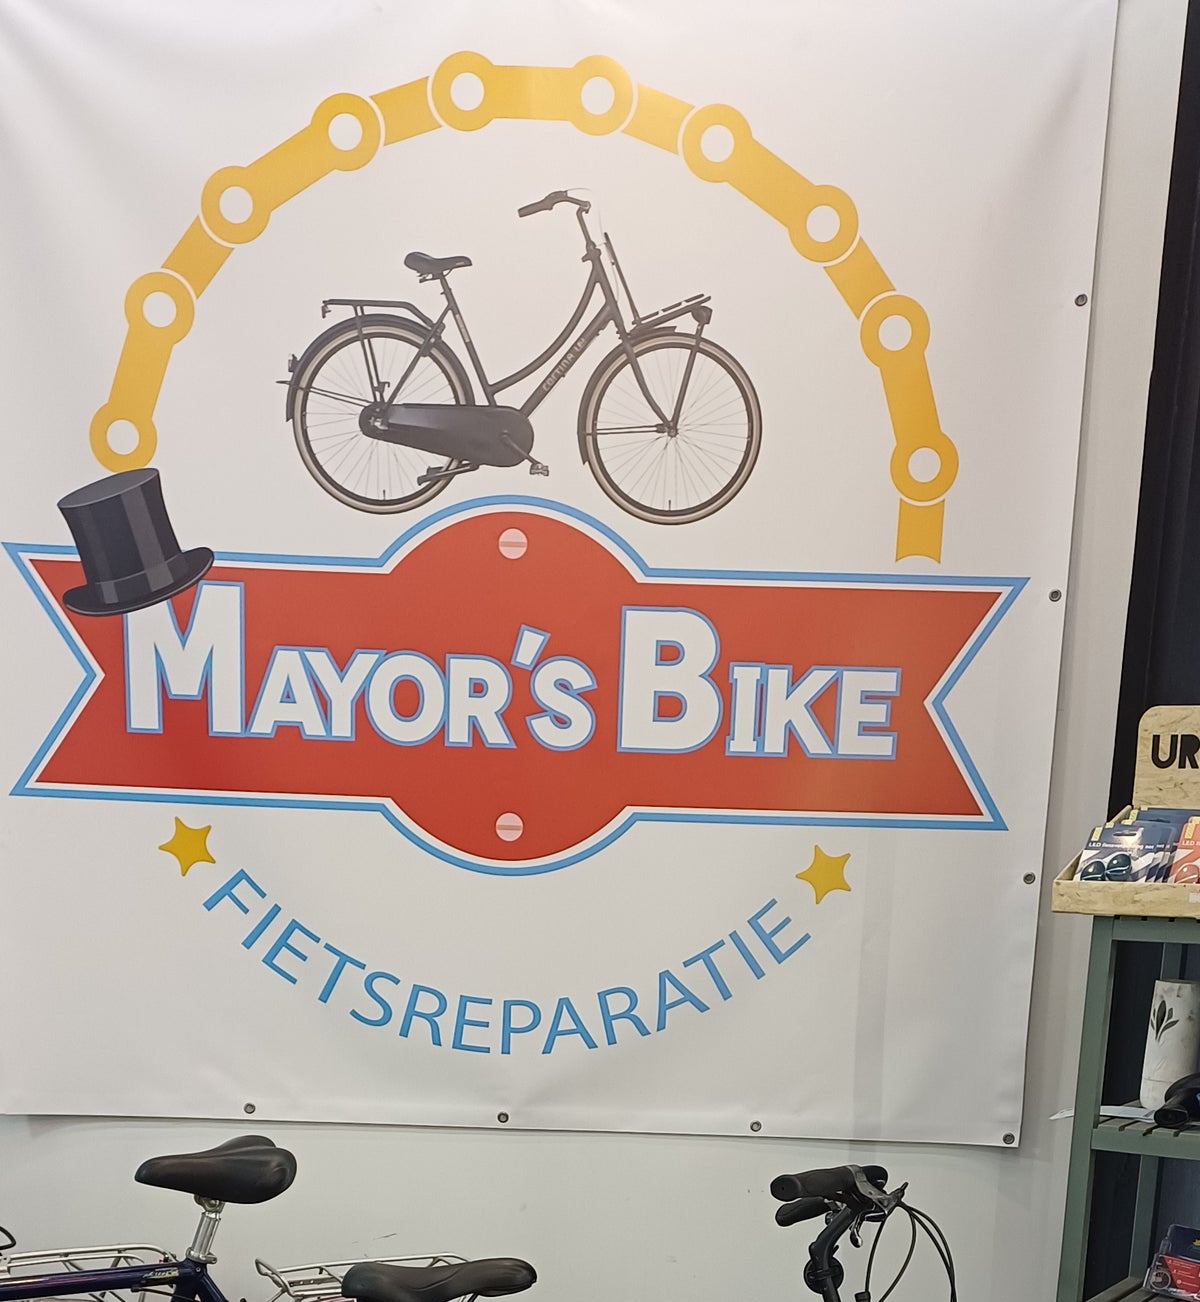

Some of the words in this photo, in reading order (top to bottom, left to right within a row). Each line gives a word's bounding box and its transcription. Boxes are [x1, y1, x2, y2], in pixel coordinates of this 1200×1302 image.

[123, 580, 598, 752] MAYOR'S
[616, 605, 902, 760] BIKE
[202, 868, 811, 1056] FIETSREPARATIE
